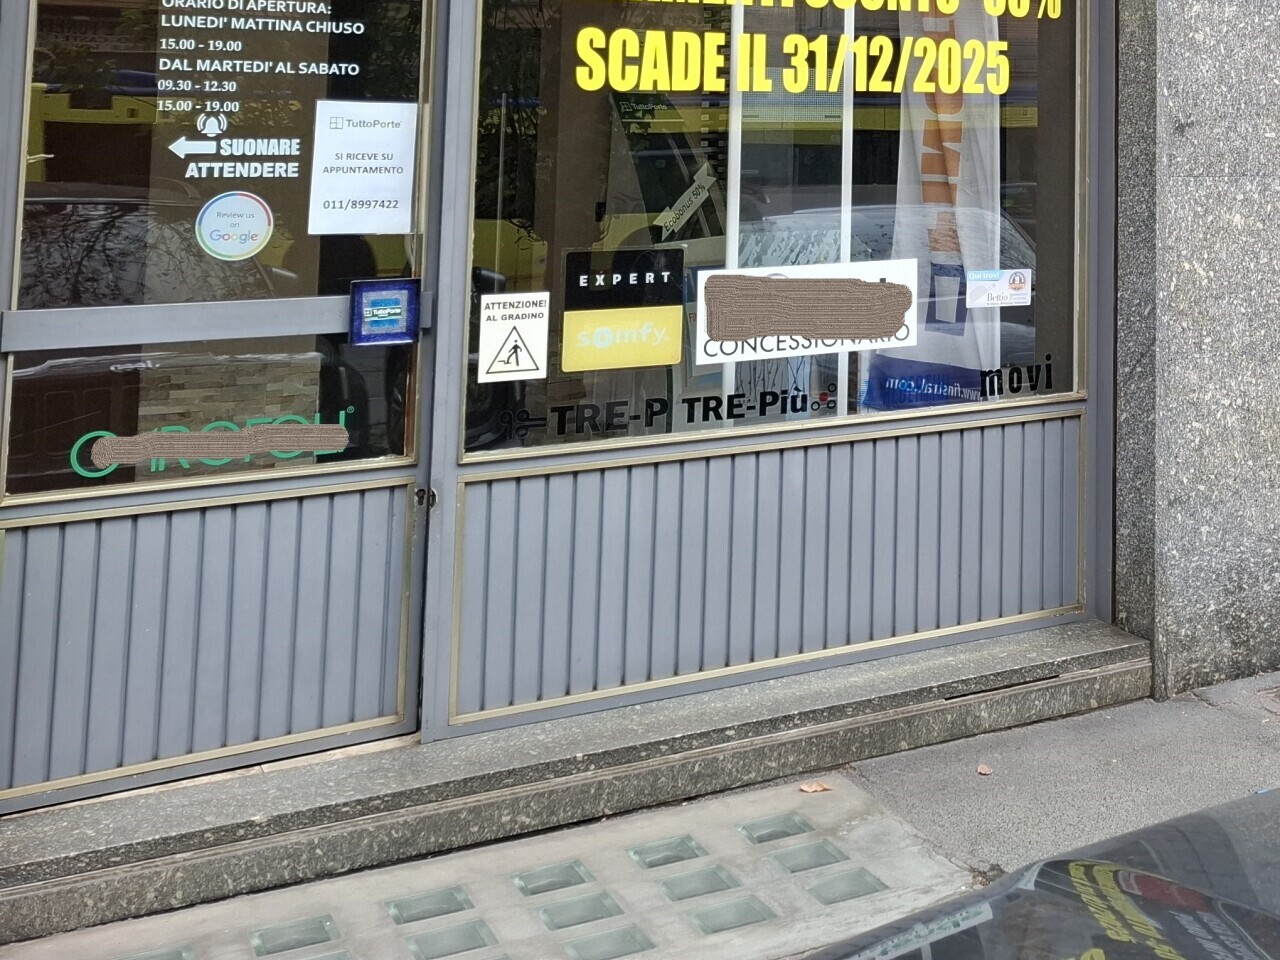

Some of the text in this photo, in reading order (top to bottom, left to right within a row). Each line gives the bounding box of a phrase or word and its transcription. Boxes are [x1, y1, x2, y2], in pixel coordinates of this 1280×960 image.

[246, 0, 332, 14] APERTURA:
[161, 15, 365, 34] LUNEDI' MATTINA CHIUSO
[160, 39, 194, 50] 15.00
[208, 40, 242, 51] 19.00
[159, 58, 360, 75] DAL MARTEDI' AL SABATO
[576, 27, 1010, 97] SCADE IL 31/12/2025
[158, 80, 191, 91] 09.30
[204, 81, 237, 92] 12.30
[157, 100, 192, 111] 15.00
[205, 101, 239, 112] 19.00
[346, 119, 402, 129] TuttoPorte
[220, 139, 300, 156] SUONARE
[335, 153, 394, 161] SI RICEVE SU
[185, 162, 299, 178] ATTENDERE
[323, 167, 404, 175] APPUNTAMENTO
[323, 199, 399, 211] 011/8997422
[663, 184, 706, 232] Ecobonus 50%
[209, 229, 258, 244] Google
[579, 271, 671, 287] EXPERT
[969, 271, 1001, 281] Qui trovi
[484, 299, 547, 311] ATTENZIONE!
[486, 312, 544, 322] AL GRADINO
[576, 322, 668, 349] somfy
[551, 386, 809, 436] TRE-P TRE-Più
